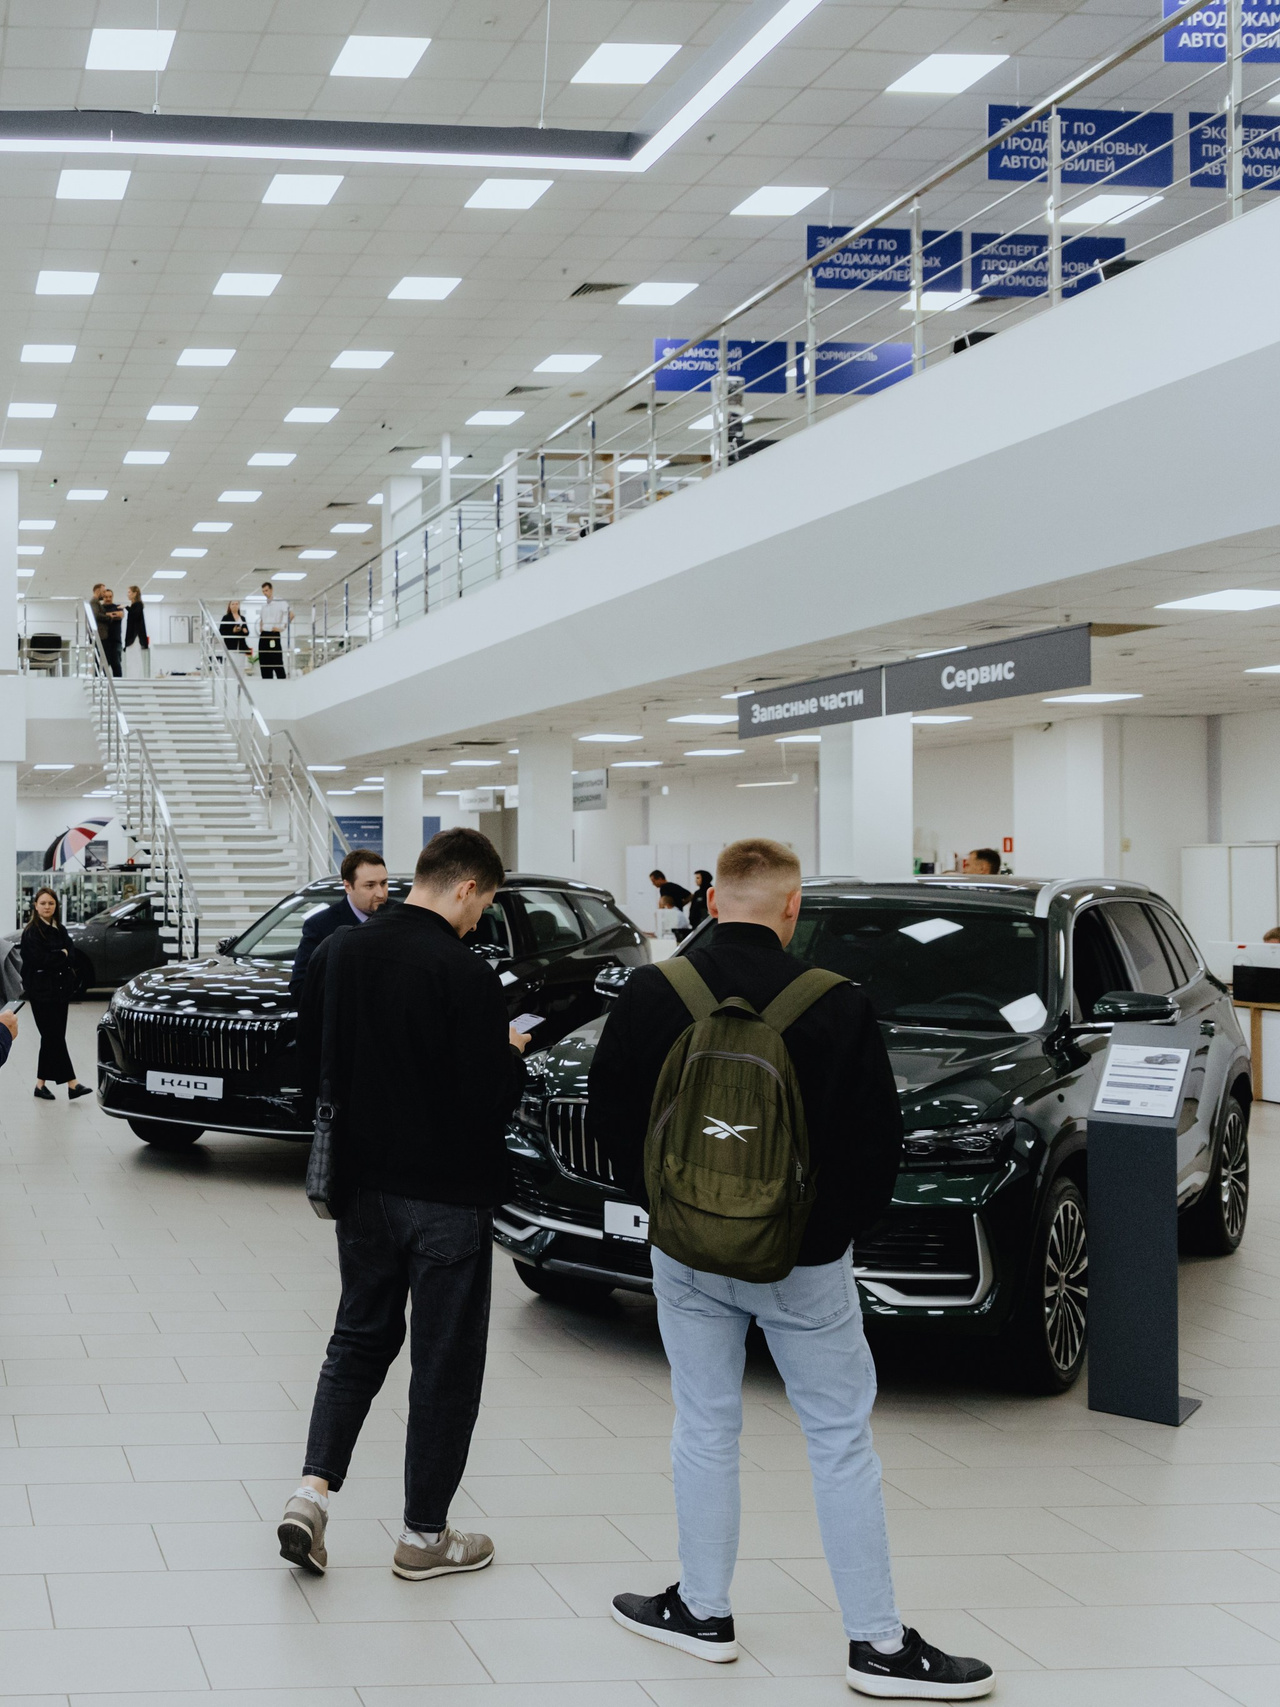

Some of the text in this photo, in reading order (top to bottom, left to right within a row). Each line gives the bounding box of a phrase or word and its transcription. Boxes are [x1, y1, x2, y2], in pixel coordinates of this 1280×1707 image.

[1179, 11, 1280, 29] ПРОДЖАМ
[1178, 32, 1280, 48] АВТООБИ
[1074, 123, 1096, 135] ПО
[1201, 126, 1268, 141] ЭКСЕРТ
[1093, 142, 1148, 156] НОВЫХ
[1202, 144, 1280, 160] ПРОАЖАМ
[1000, 155, 1115, 172] АВТОМБИЛЕЙ
[1201, 162, 1280, 178] АВТМОБИ
[816, 236, 897, 250] ЭКЕРТ ПО
[981, 244, 1039, 257] ЭКСПЕРТ
[818, 251, 942, 267] ОДАЖАМ НЫХ
[981, 274, 1078, 288] АВТОМОБИЕЙ
[662, 347, 743, 359] ФАНСОЫЙ
[662, 360, 743, 372] ОНСУЛЬТНТ
[941, 660, 1016, 692] Сервис
[750, 688, 864, 724] Запасные части
